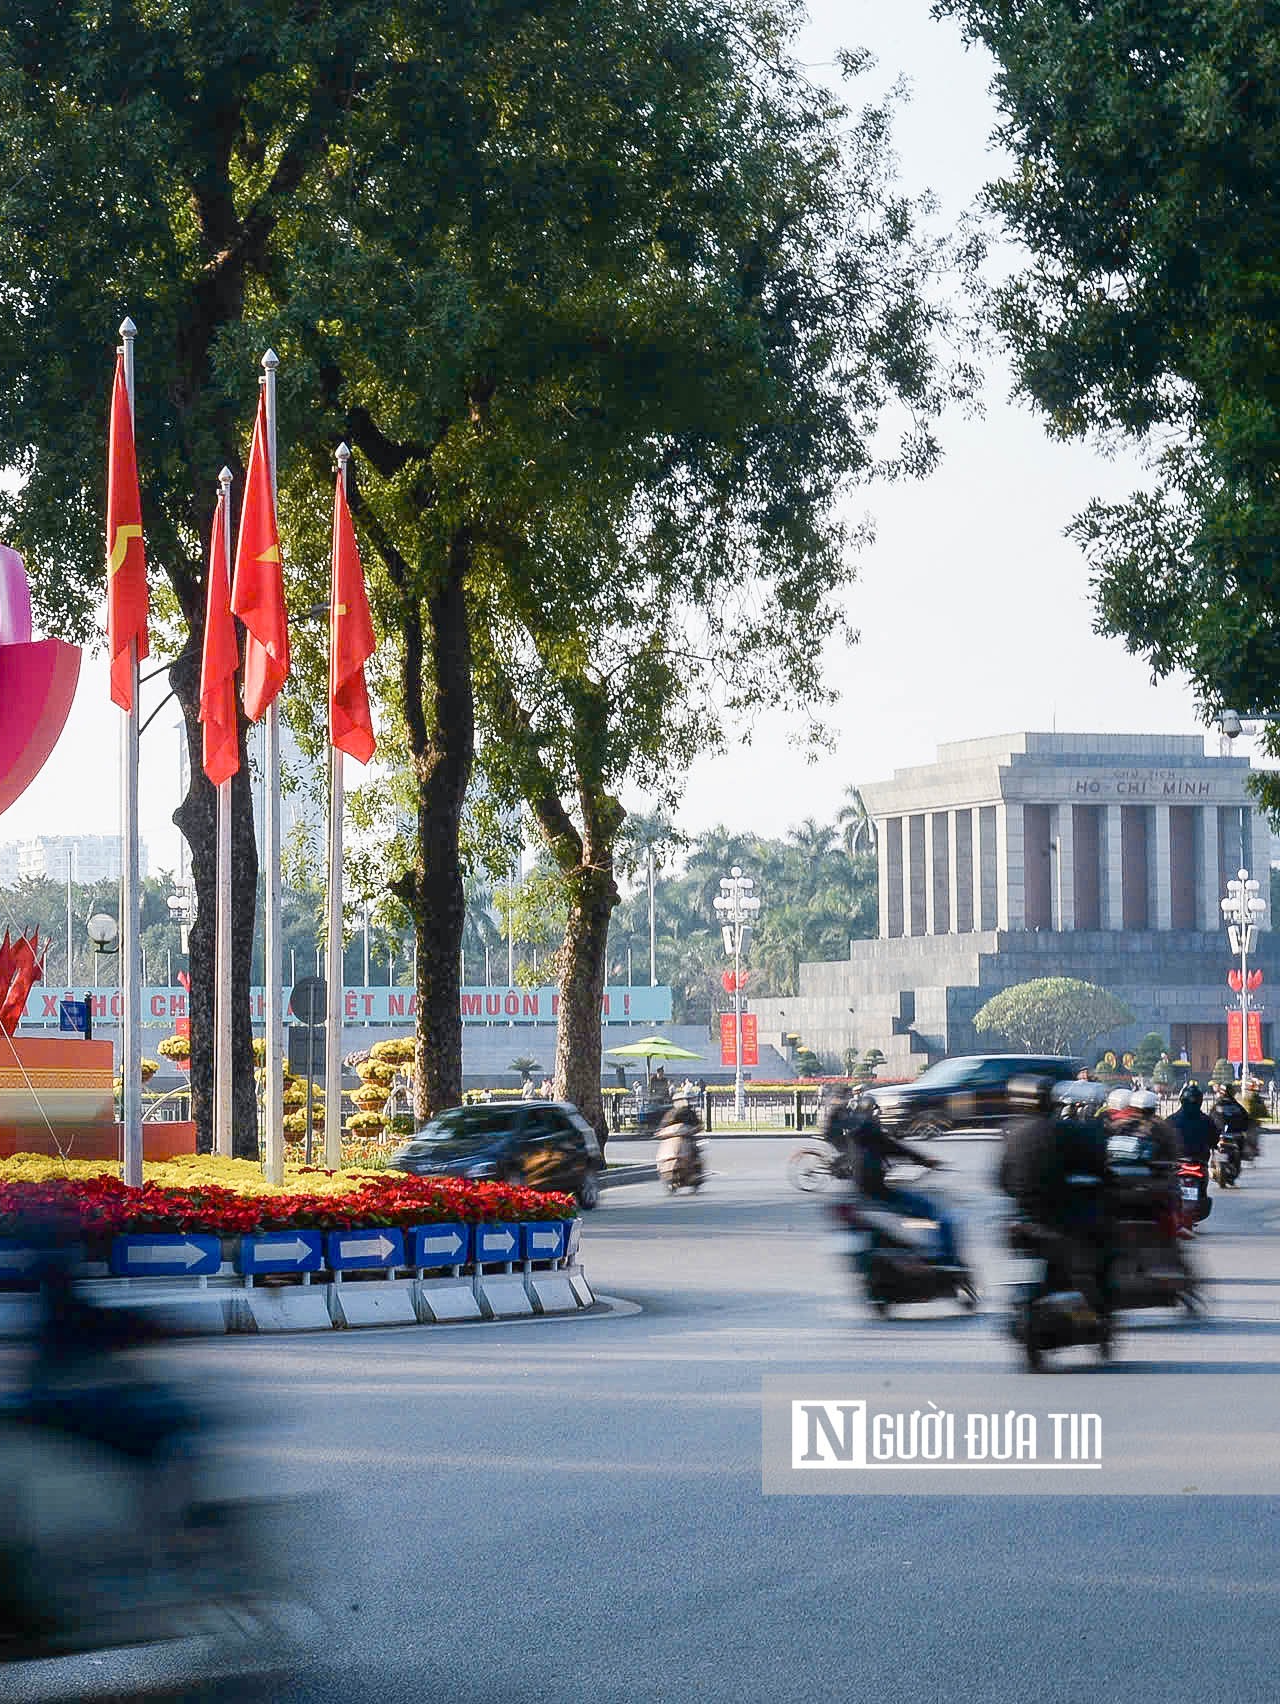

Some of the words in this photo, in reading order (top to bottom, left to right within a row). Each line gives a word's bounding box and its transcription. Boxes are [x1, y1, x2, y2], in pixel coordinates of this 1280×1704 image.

[1162, 781, 1210, 795] MINH
[91, 991, 124, 1020] HỘ
[150, 995, 185, 1016] CH
[344, 990, 375, 1020] ỆT
[388, 994, 417, 1016] NA
[461, 990, 539, 1016] MUÔN
